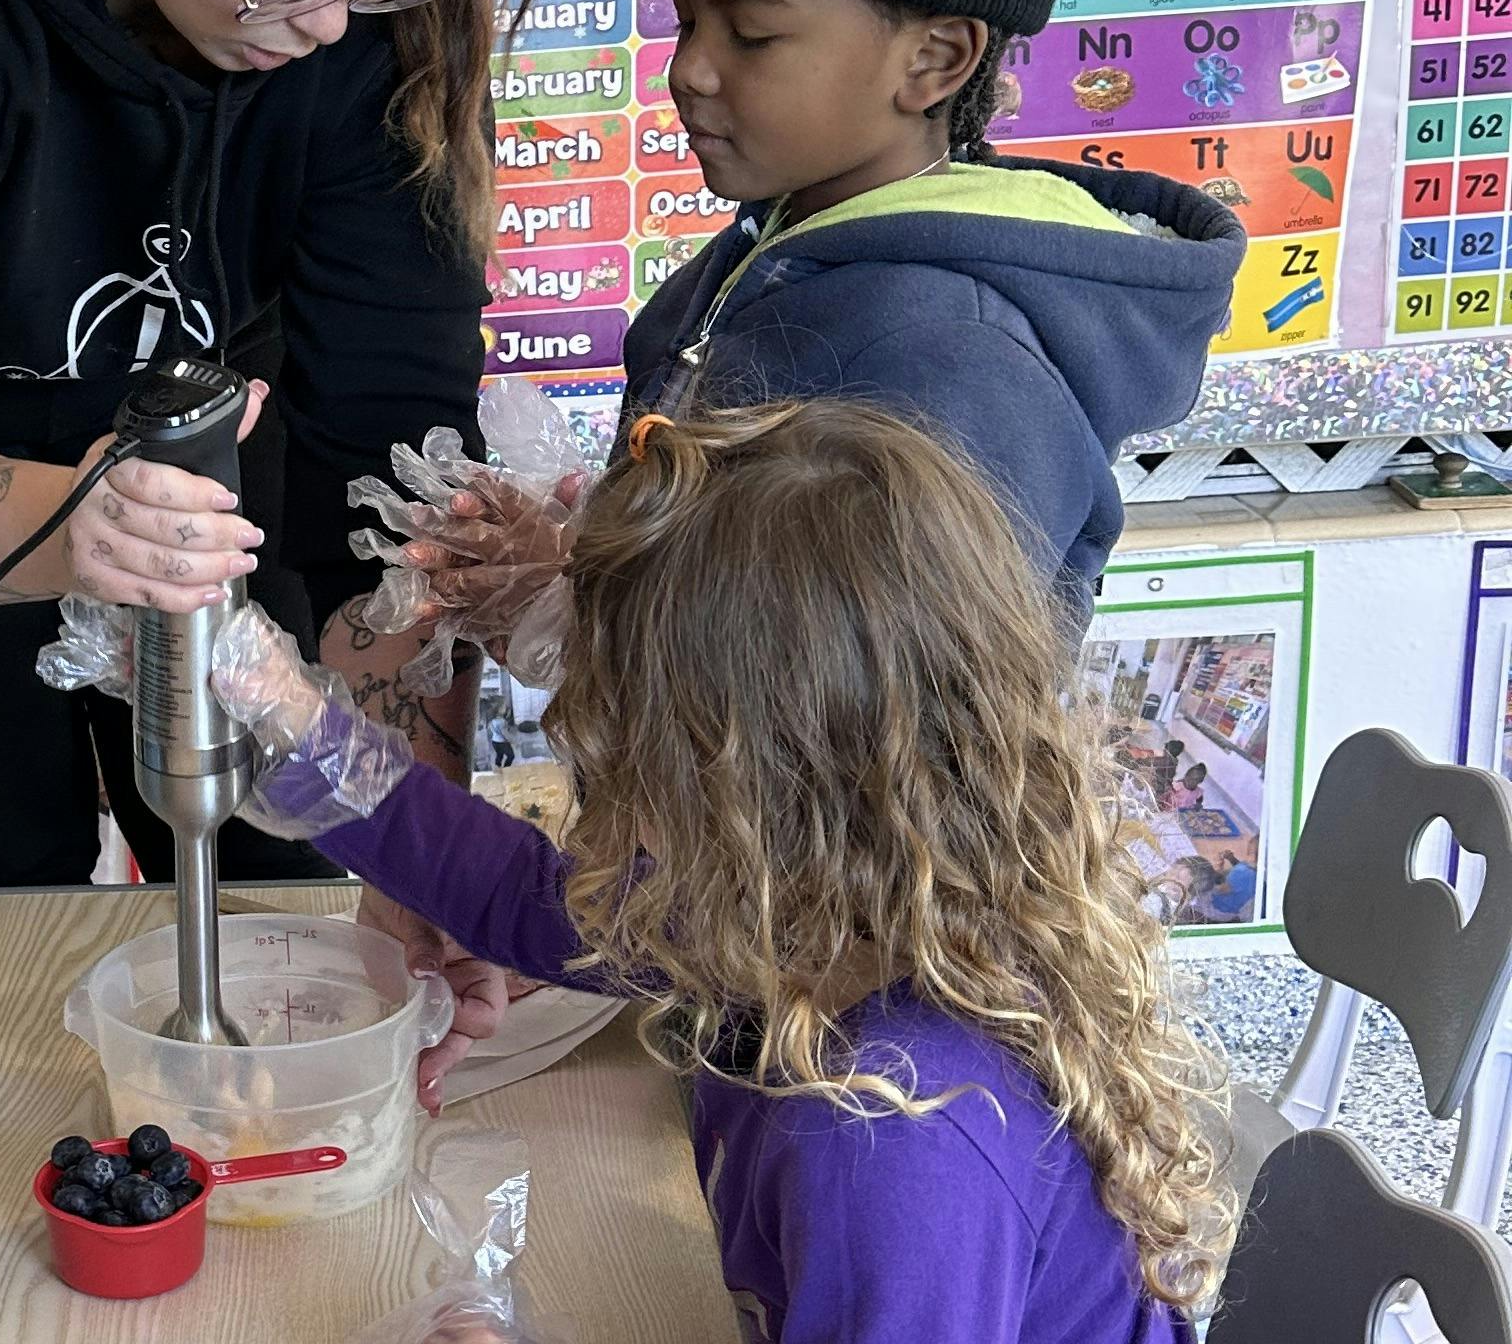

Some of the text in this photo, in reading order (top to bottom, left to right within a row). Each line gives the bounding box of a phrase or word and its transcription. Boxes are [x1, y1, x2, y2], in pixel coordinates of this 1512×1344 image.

[1078, 26, 1133, 61] Nn
[1184, 19, 1241, 55] Oo
[1294, 12, 1341, 54] Pp
[490, 68, 622, 100] ebruary
[1420, 53, 1507, 83] 51 52
[1091, 116, 1115, 128] nest
[1188, 109, 1231, 122] octopus
[1417, 113, 1503, 143] 61 62
[495, 129, 602, 167] March
[1191, 136, 1228, 171] Tt
[1287, 131, 1333, 163] Uu
[1414, 173, 1499, 202] 71 72
[497, 196, 591, 244] April
[1284, 214, 1323, 229] umbrella
[1280, 244, 1319, 277] Zz
[1410, 232, 1495, 260] 81 82
[508, 266, 584, 300] May
[1406, 290, 1490, 317] 91 92
[496, 330, 592, 364] June
[1280, 328, 1306, 342] zipper
